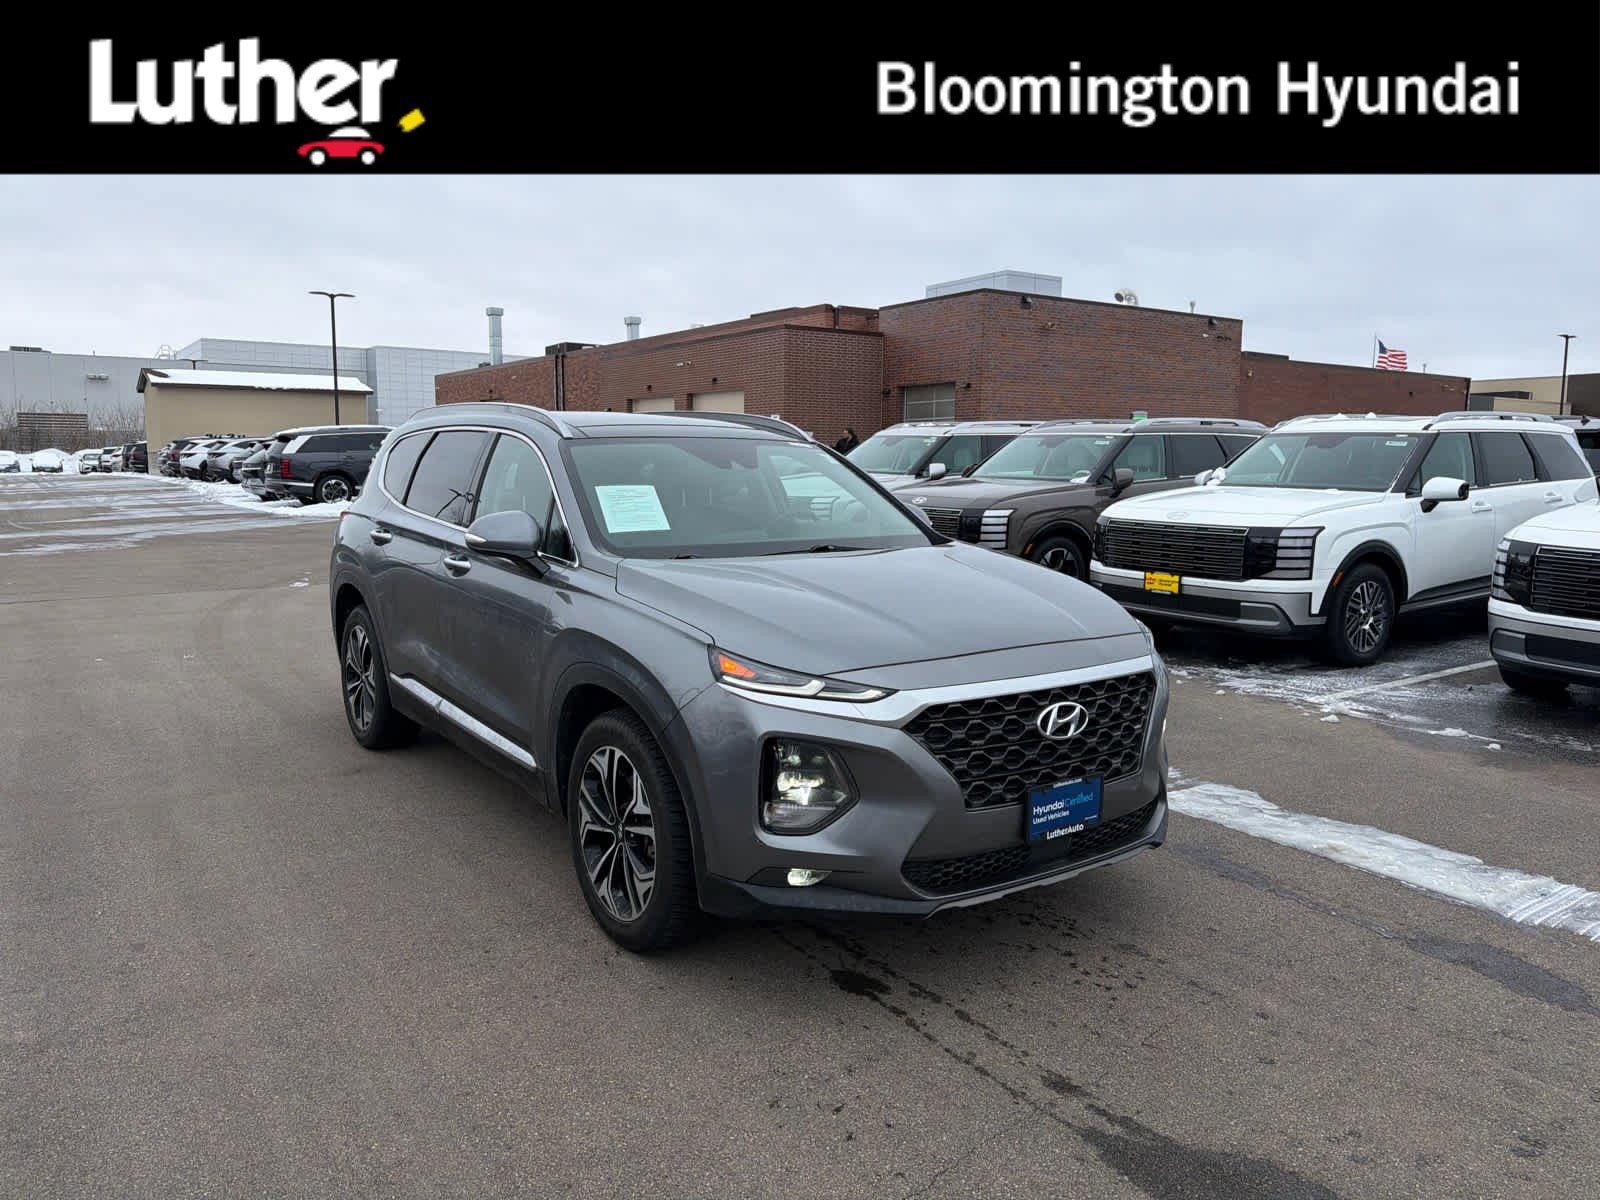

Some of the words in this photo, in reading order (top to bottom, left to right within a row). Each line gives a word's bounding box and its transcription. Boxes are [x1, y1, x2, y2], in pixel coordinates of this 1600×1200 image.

[1033, 816, 1047, 825] Used
[1048, 810, 1070, 821] Vehicles
[1046, 824, 1084, 840] LutherAuto
